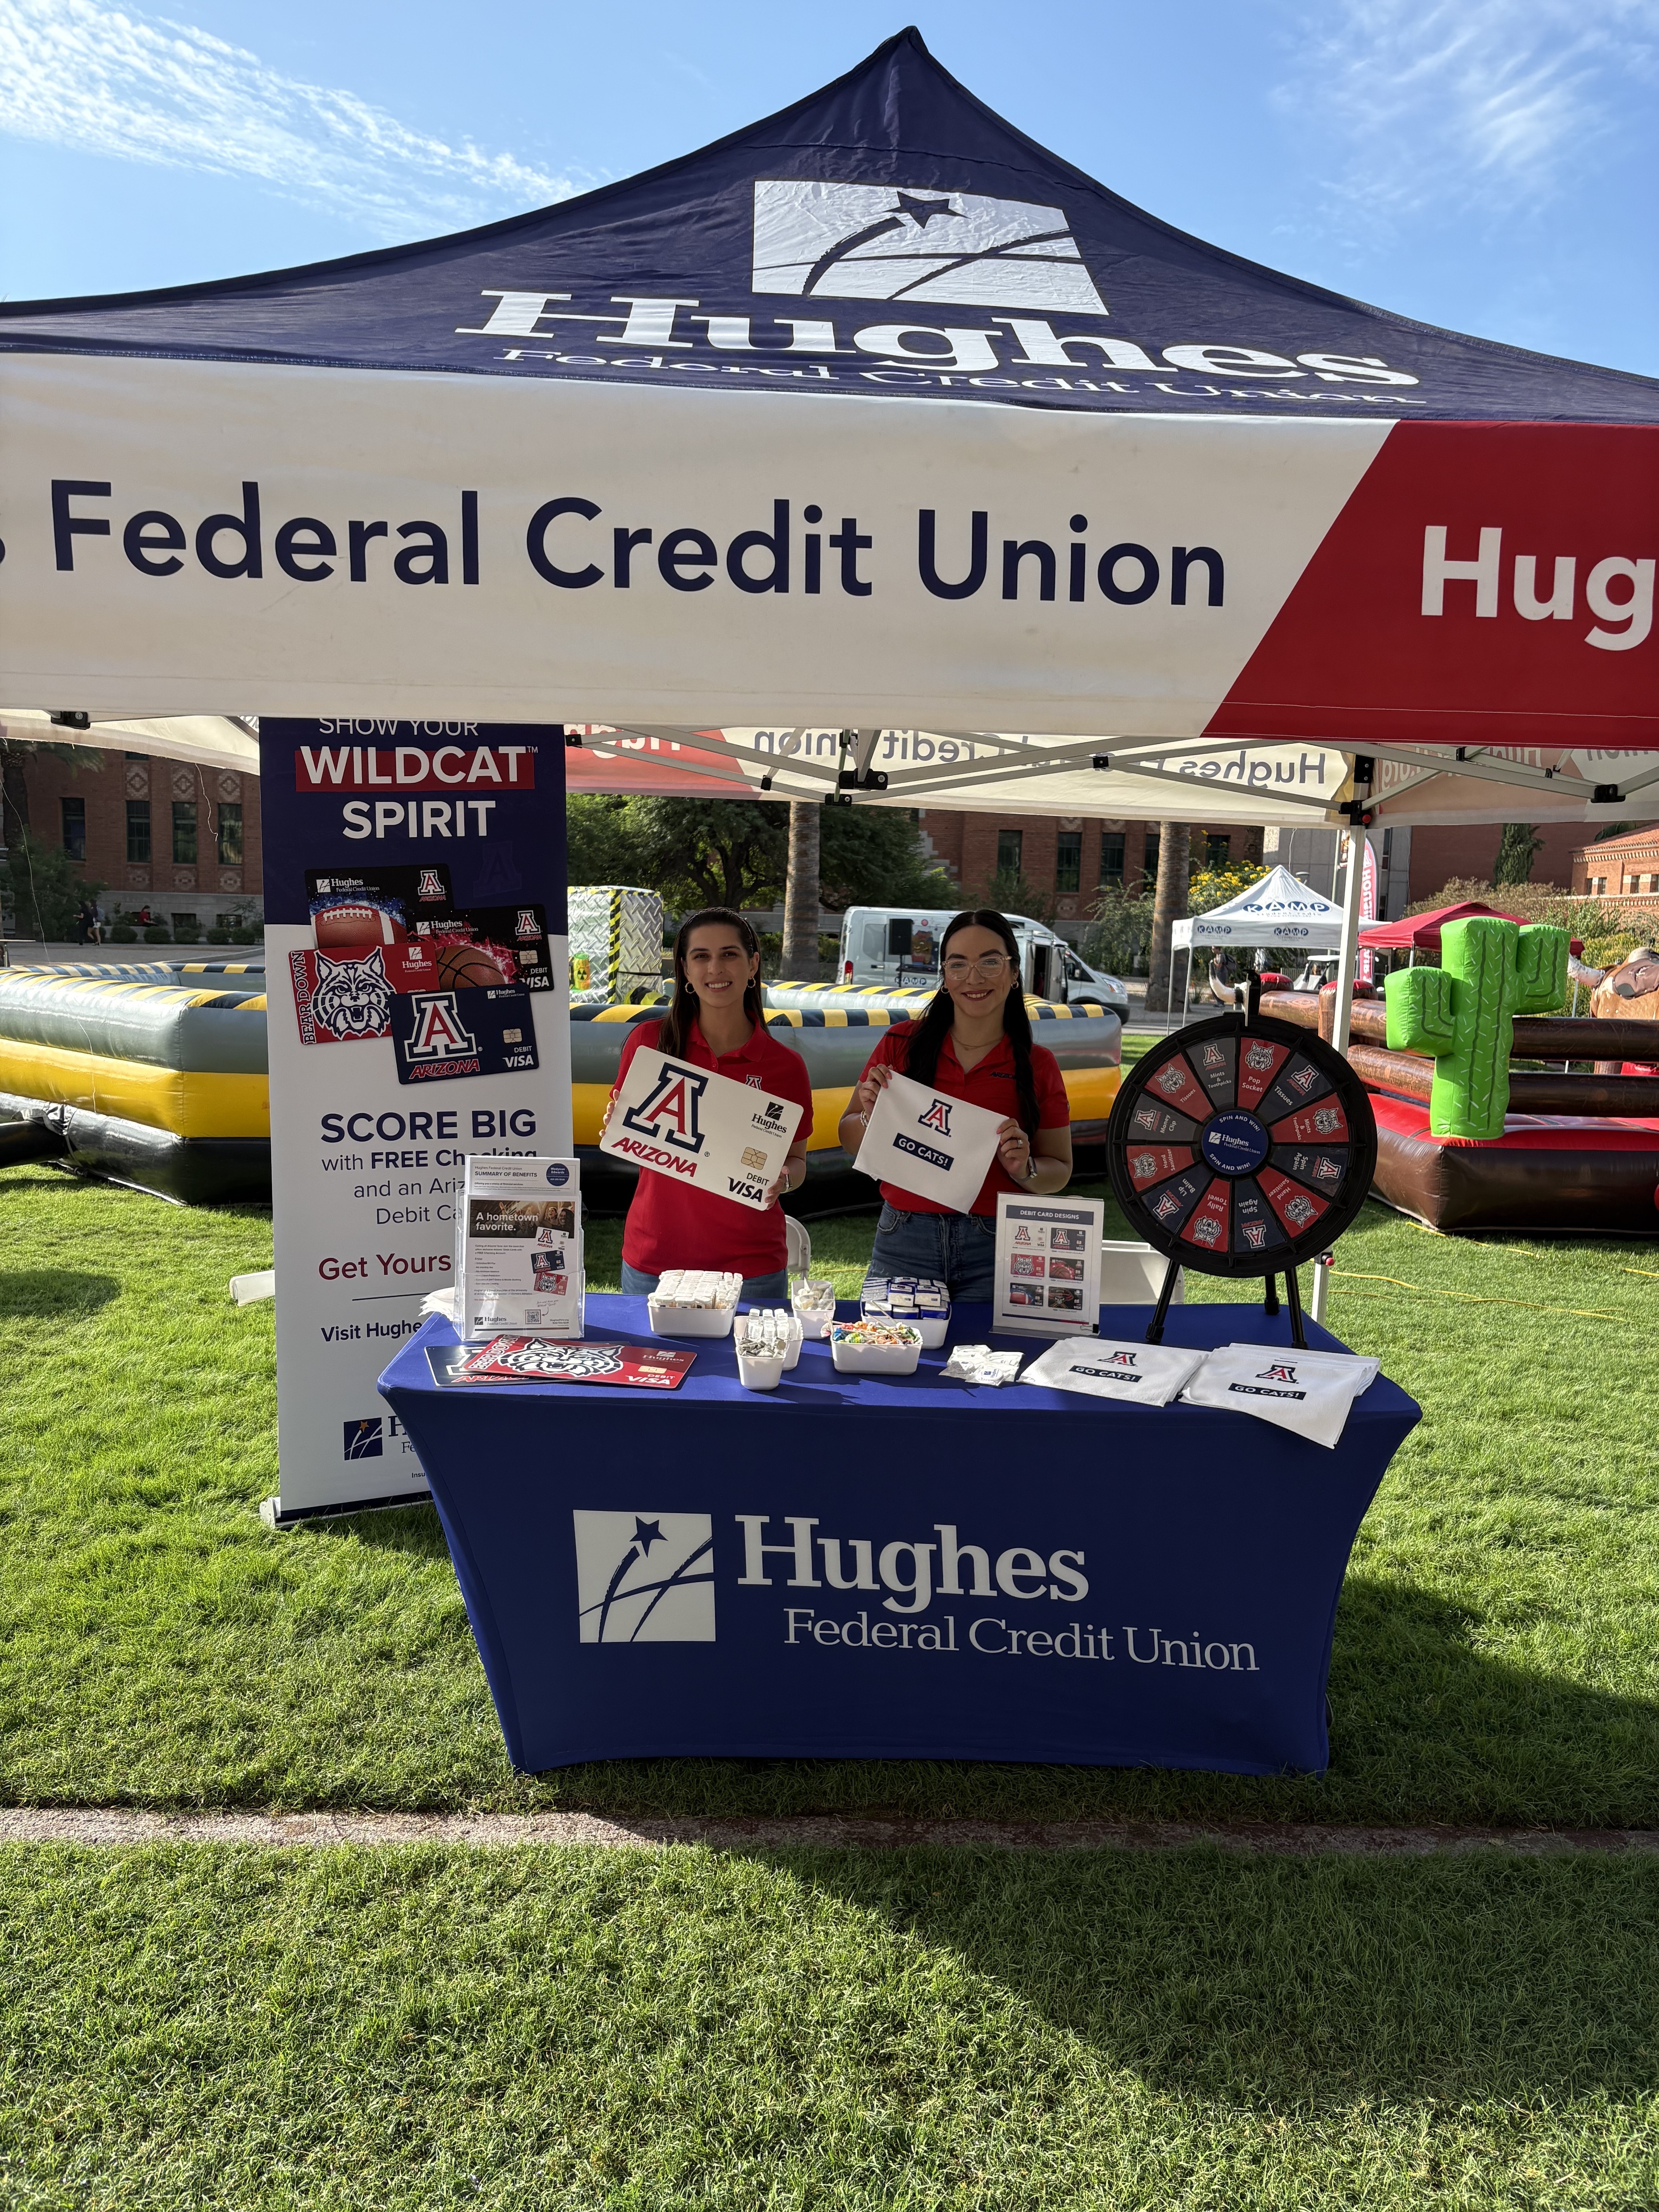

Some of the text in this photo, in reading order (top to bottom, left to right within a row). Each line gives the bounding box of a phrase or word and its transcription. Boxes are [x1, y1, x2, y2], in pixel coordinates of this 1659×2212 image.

[455, 290, 1419, 384] Hughes
[493, 349, 1427, 403] Federal Credit Union
[52, 479, 1224, 606] Federal Credit Union
[1421, 526, 1656, 651] Hug
[319, 718, 479, 736] SHOW YOUR
[343, 801, 496, 839] SPIRIT
[331, 879, 363, 887] Hughes
[418, 870, 445, 895] A
[1242, 899, 1330, 913] KAMP
[431, 921, 462, 929] Hughes
[515, 910, 541, 935] A
[1197, 924, 1231, 934] KAMP
[1274, 926, 1309, 936] KAMP
[402, 960, 432, 969] Hughes
[291, 951, 317, 1044] BEAR DOWN
[404, 991, 477, 1062] A
[409, 1059, 480, 1079] ARIZONA
[502, 1054, 534, 1068] VISA
[1208, 1079, 1231, 1089] Toothpicks
[1242, 1082, 1263, 1092] Socket
[1248, 1076, 1261, 1084] Pop
[1180, 1089, 1196, 1103] Tissues
[1274, 1086, 1293, 1106] Tissues
[622, 1062, 709, 1154] A
[918, 1098, 953, 1136] A
[321, 1109, 536, 1143] SCORE BIG
[752, 1113, 787, 1133] Hughes
[1160, 1114, 1171, 1133] Money
[1249, 1120, 1260, 1132] WIN!
[1293, 1117, 1302, 1140] Toothpicks
[1222, 1134, 1249, 1146] Hughes
[321, 1154, 363, 1171] with
[371, 1150, 428, 1169] FREE
[611, 1137, 697, 1177] ARIZONA
[898, 1138, 948, 1166] GO CATS!
[1167, 1149, 1175, 1171] Sanitizer
[1293, 1152, 1302, 1170] Again
[1209, 1153, 1221, 1166] SPIN
[1237, 1162, 1251, 1170] WIN!
[1300, 1156, 1308, 1170] Spin
[746, 1173, 769, 1186] DEBIT
[1182, 1178, 1195, 1193] Balm
[1269, 1178, 1290, 1197] Sanitizer
[354, 1180, 390, 1198] and
[398, 1182, 422, 1195] an
[728, 1176, 764, 1202] VISA
[1178, 1186, 1187, 1197] Lip
[1277, 1187, 1291, 1200] Hand
[1207, 1194, 1227, 1205] Towel
[1207, 1202, 1223, 1212] Rally
[1239, 1199, 1258, 1207] Again
[377, 1206, 430, 1224] Debit
[476, 1212, 538, 1221] A hometown
[476, 1222, 516, 1231] favorite.
[319, 1257, 368, 1280] Get
[376, 1253, 452, 1275] Yours
[321, 1325, 361, 1342] Visit
[1098, 1351, 1138, 1366] A
[625, 1375, 670, 1385] VISA
[1075, 1366, 1136, 1381] GO CATS!
[1255, 1364, 1298, 1383] A
[1235, 1385, 1299, 1398] GO CATS!
[735, 1514, 1089, 1614] Hughes
[783, 1608, 1259, 1671] Federal Credit Union
